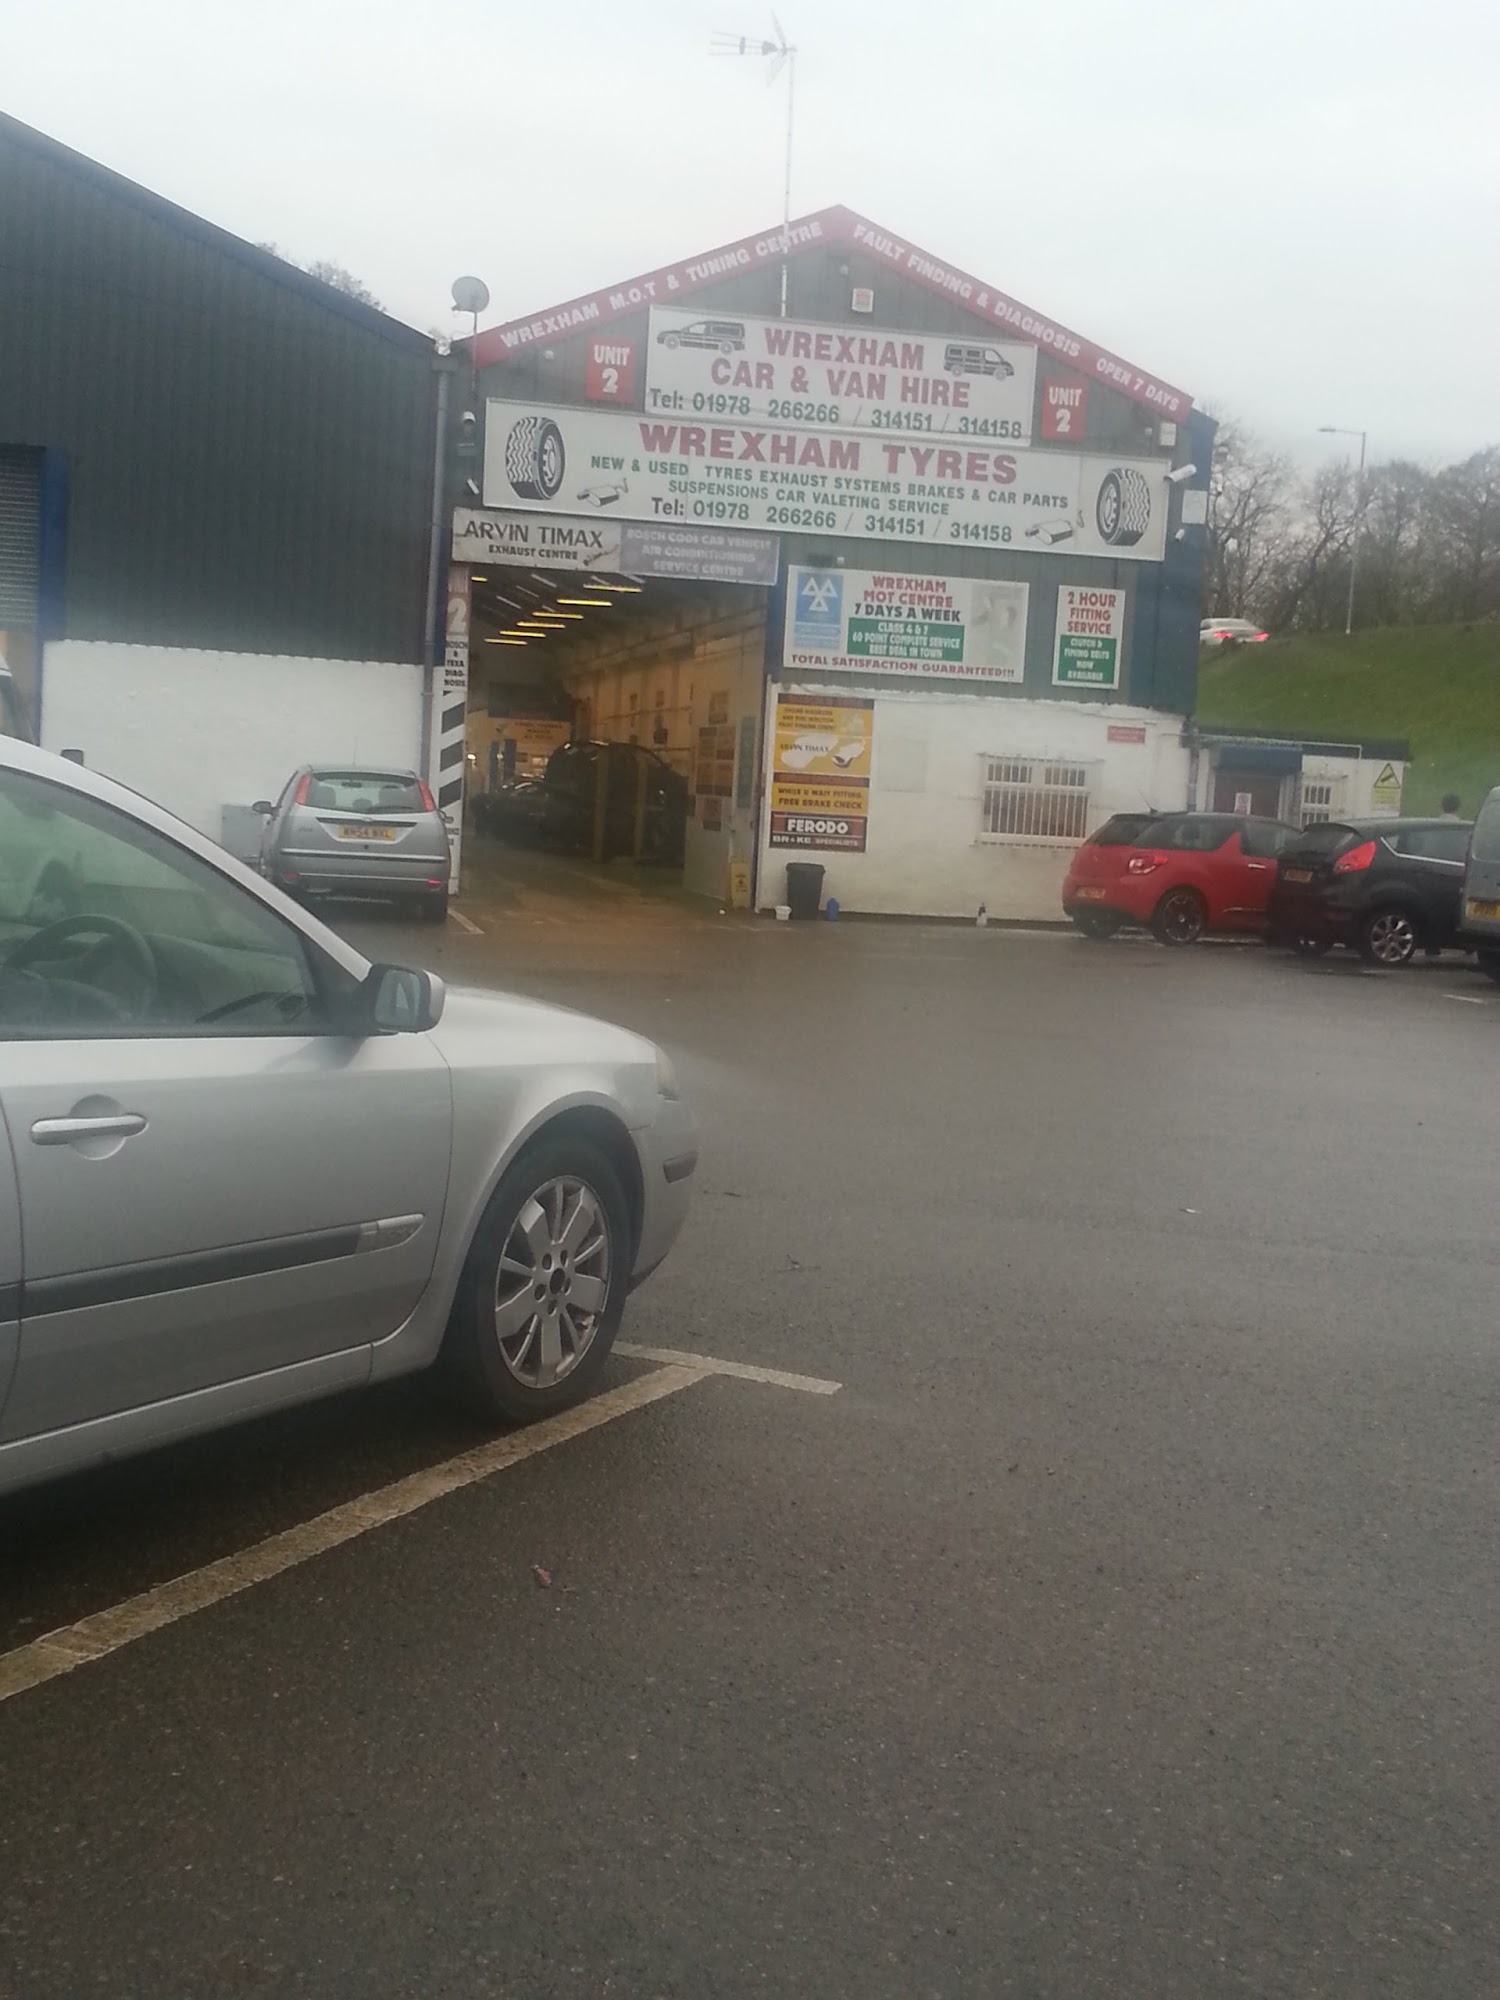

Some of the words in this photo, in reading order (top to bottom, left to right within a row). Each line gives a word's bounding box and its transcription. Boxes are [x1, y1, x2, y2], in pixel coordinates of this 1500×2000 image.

[500, 303, 600, 348] WREXHAM
[609, 281, 656, 310] M.O.T
[667, 274, 679, 290] &
[686, 249, 750, 282] TUNING
[756, 221, 823, 256] CENTRE
[853, 224, 905, 261] FAULT
[907, 254, 972, 298] FINDING
[977, 292, 988, 307] &
[994, 301, 1081, 358] DIAGNOSIS
[1096, 358, 1129, 384] OPEN
[1133, 378, 1143, 391] 7
[1146, 384, 1179, 411] DAYS
[593, 344, 630, 366] UNIT
[765, 327, 924, 371] WREXHAM
[602, 367, 618, 393] 2
[711, 358, 774, 390] CAR
[790, 365, 809, 393] &
[827, 369, 886, 401] VAN
[901, 377, 970, 408] HIRE
[1049, 386, 1082, 407] UNIT
[650, 388, 683, 410] Tel:
[692, 392, 750, 415] 01978
[768, 400, 840, 424] 266266
[871, 409, 933, 432] 314151
[959, 417, 1022, 439] 314158
[1056, 409, 1071, 432] 2
[639, 423, 860, 471] WREXHAM
[882, 444, 1017, 484] TYRES
[591, 456, 625, 471] NEW
[632, 459, 640, 472] &
[649, 461, 688, 475] USED
[705, 465, 752, 481] TYRES
[760, 470, 827, 487] EXHAUST
[834, 477, 900, 494] SYSTEMS
[908, 484, 965, 500] BRAKES
[972, 490, 980, 501] &
[988, 490, 1016, 504] CAR
[1023, 493, 1068, 508] PARTS
[669, 480, 768, 500] SUSPENSIONS
[776, 489, 805, 503] CAR
[813, 491, 880, 510] VALETING
[888, 499, 949, 515] SERVICE
[651, 497, 684, 516] Tel:
[693, 500, 749, 520] 01978
[766, 506, 836, 529] 266266
[865, 515, 925, 535] 314151
[951, 522, 1012, 543] 314158
[464, 520, 529, 543] ARVIN
[538, 526, 603, 549] TIMAX
[488, 544, 536, 557] EXHAUST
[538, 549, 578, 560] CENTRE
[872, 575, 946, 593] WREXHAM
[863, 590, 894, 604] MOT
[898, 592, 953, 608] CENTRE
[1068, 591, 1075, 604] 2
[1079, 592, 1117, 608] HOUR
[854, 603, 862, 615] 7
[865, 604, 903, 619] DAYS
[907, 606, 920, 620] A
[922, 608, 961, 622] WEEK
[1070, 607, 1111, 622] FITTING
[1067, 621, 1111, 635] SERVICE
[792, 654, 828, 665] TOTAL
[832, 655, 917, 672] SATISFACTION
[778, 797, 800, 806] FREE
[802, 799, 831, 808] BRAKE
[834, 800, 862, 810] CHECK
[787, 818, 848, 834] FERODO
